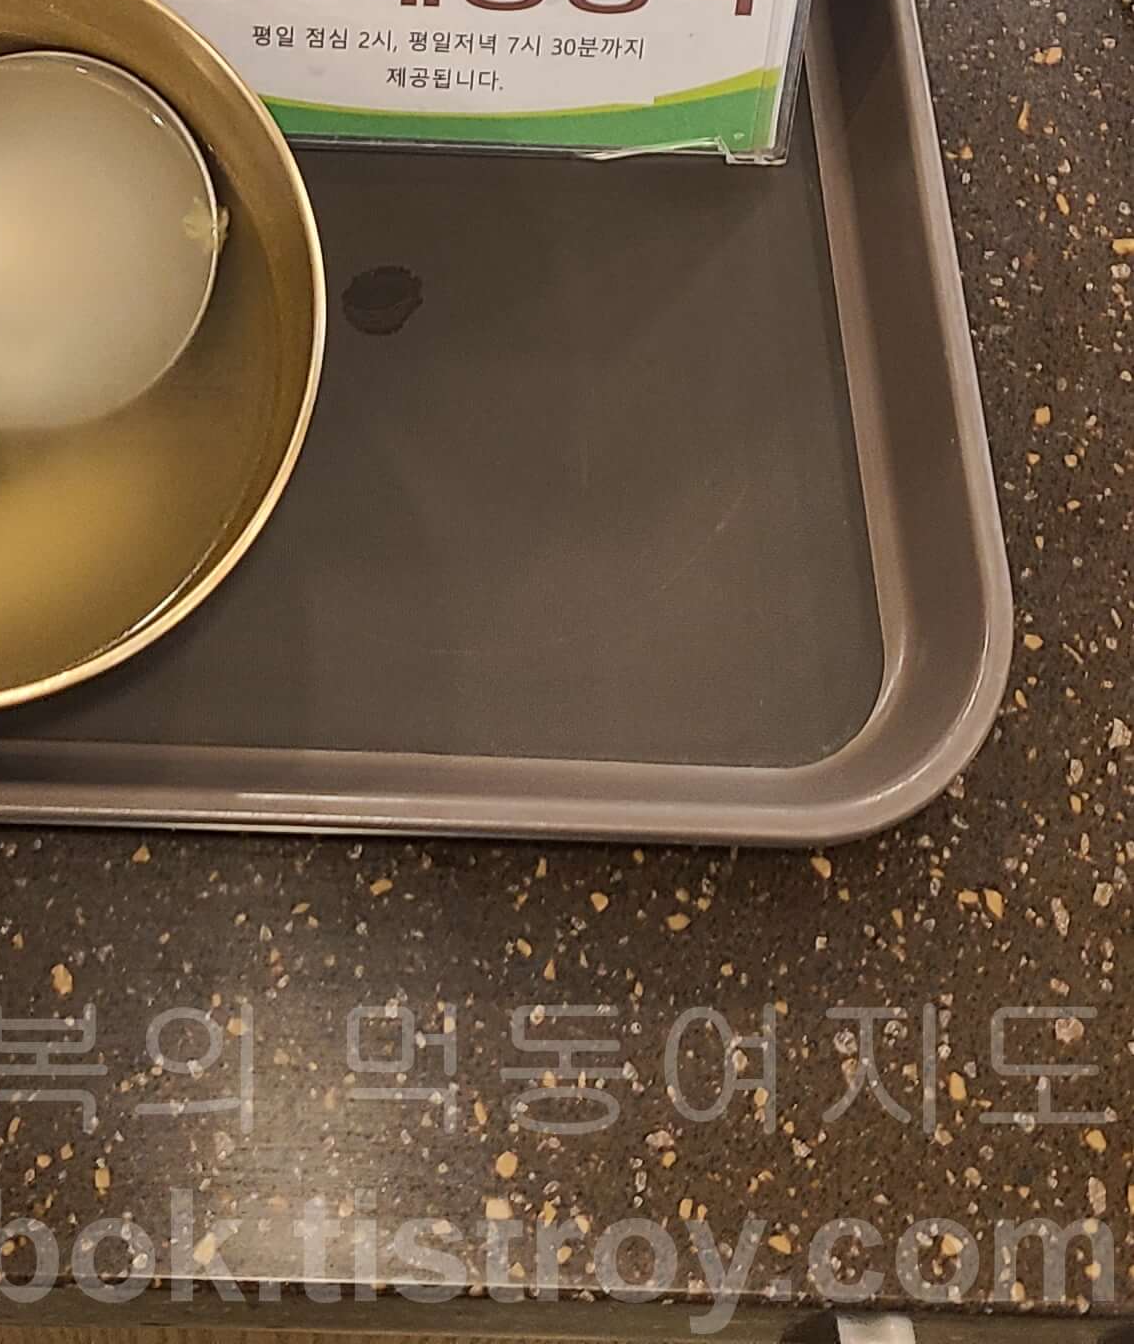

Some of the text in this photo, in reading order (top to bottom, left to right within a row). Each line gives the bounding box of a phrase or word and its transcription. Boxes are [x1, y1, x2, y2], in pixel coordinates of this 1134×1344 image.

[252, 25, 645, 60] 평일 점심 2시, 평일저녁 7시 30분까지
[386, 66, 504, 91] 제공됩니다.
